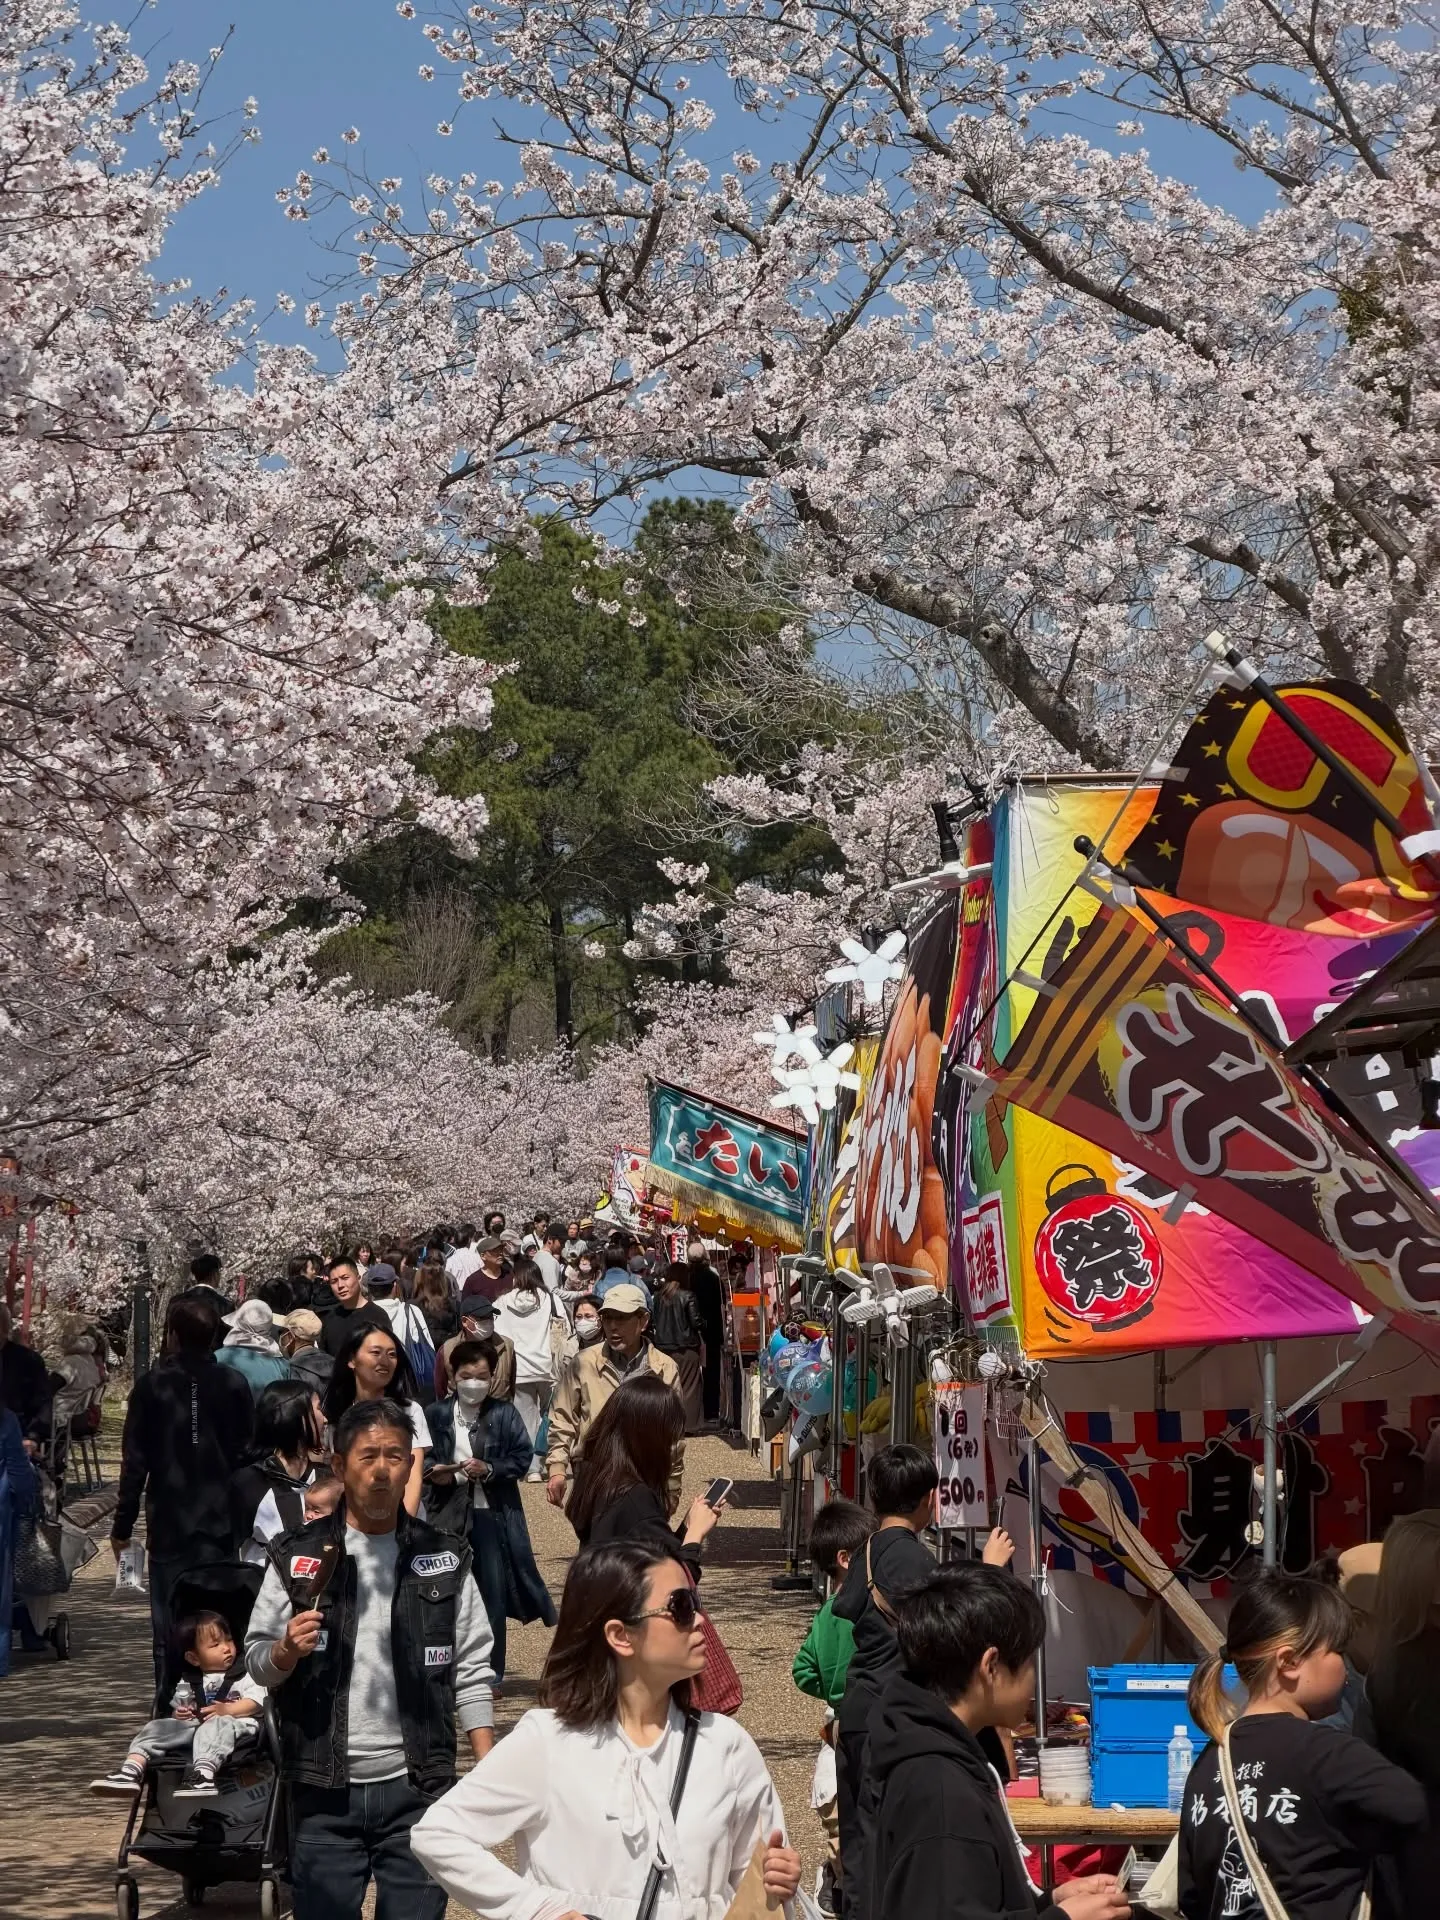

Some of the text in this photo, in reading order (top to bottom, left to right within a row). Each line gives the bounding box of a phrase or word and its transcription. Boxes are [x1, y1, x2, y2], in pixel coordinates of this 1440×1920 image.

[693, 1119, 800, 1192] たい
[1050, 1205, 1154, 1312] 祭
[418, 1555, 454, 1571] SHOEI
